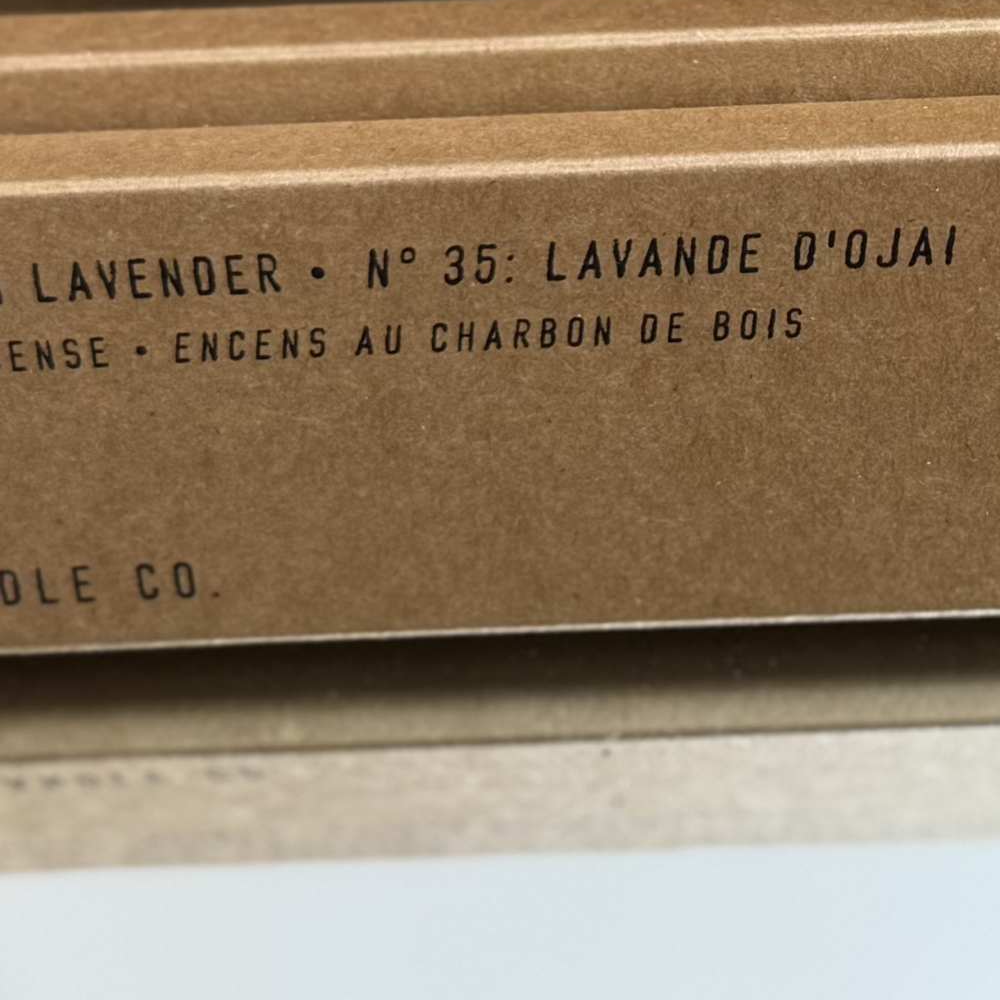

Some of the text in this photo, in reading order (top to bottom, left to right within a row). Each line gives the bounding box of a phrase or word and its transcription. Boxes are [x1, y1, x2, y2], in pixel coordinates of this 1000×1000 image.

[31, 252, 282, 304] LAVENDER
[443, 243, 515, 287] 35:
[545, 232, 763, 282] LAVANDE
[793, 224, 957, 273] D'OJAI
[174, 327, 326, 364] ENCENS
[354, 324, 402, 357] AU
[430, 315, 612, 354] CHARBON
[640, 311, 685, 345] DE
[712, 307, 803, 342] BOIS
[134, 561, 221, 601] CO.
